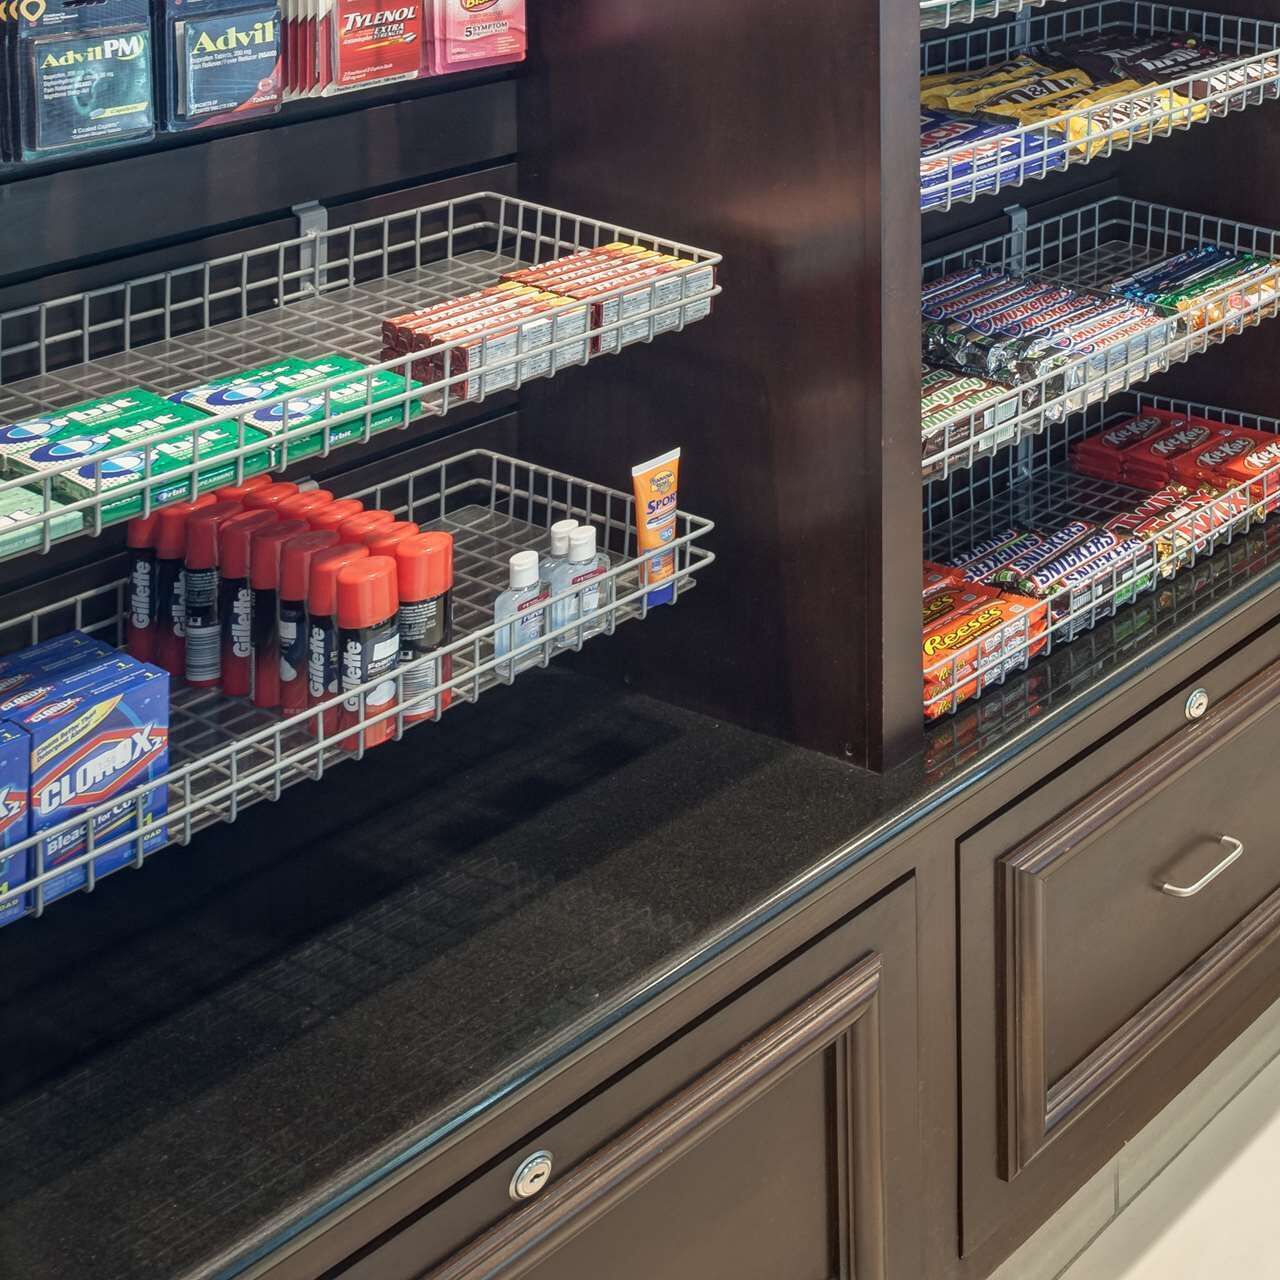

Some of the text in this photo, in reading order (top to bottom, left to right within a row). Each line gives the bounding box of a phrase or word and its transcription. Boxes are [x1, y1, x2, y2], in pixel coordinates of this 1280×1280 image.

[192, 20, 275, 55] Advil
[343, 6, 417, 34] TYLENOL
[374, 22, 405, 35] EXTRA
[464, 26, 473, 38] 5
[473, 21, 508, 32] SYMPTOM
[40, 36, 139, 69] Advil PM
[991, 290, 1071, 328] Musketeers
[158, 486, 187, 501] Orbit
[1104, 486, 1182, 531] TWIX
[944, 530, 1017, 567] SNICKER
[1015, 522, 1086, 571] SNICKERS
[1036, 531, 1115, 585] SNICKERS
[131, 560, 151, 629] Gillette
[231, 588, 252, 658] Gillette
[923, 606, 1002, 656] Reese's
[308, 626, 326, 698] Gillette
[342, 640, 362, 712] Gillette
[97, 810, 112, 826] for
[143, 828, 162, 841] OAD
